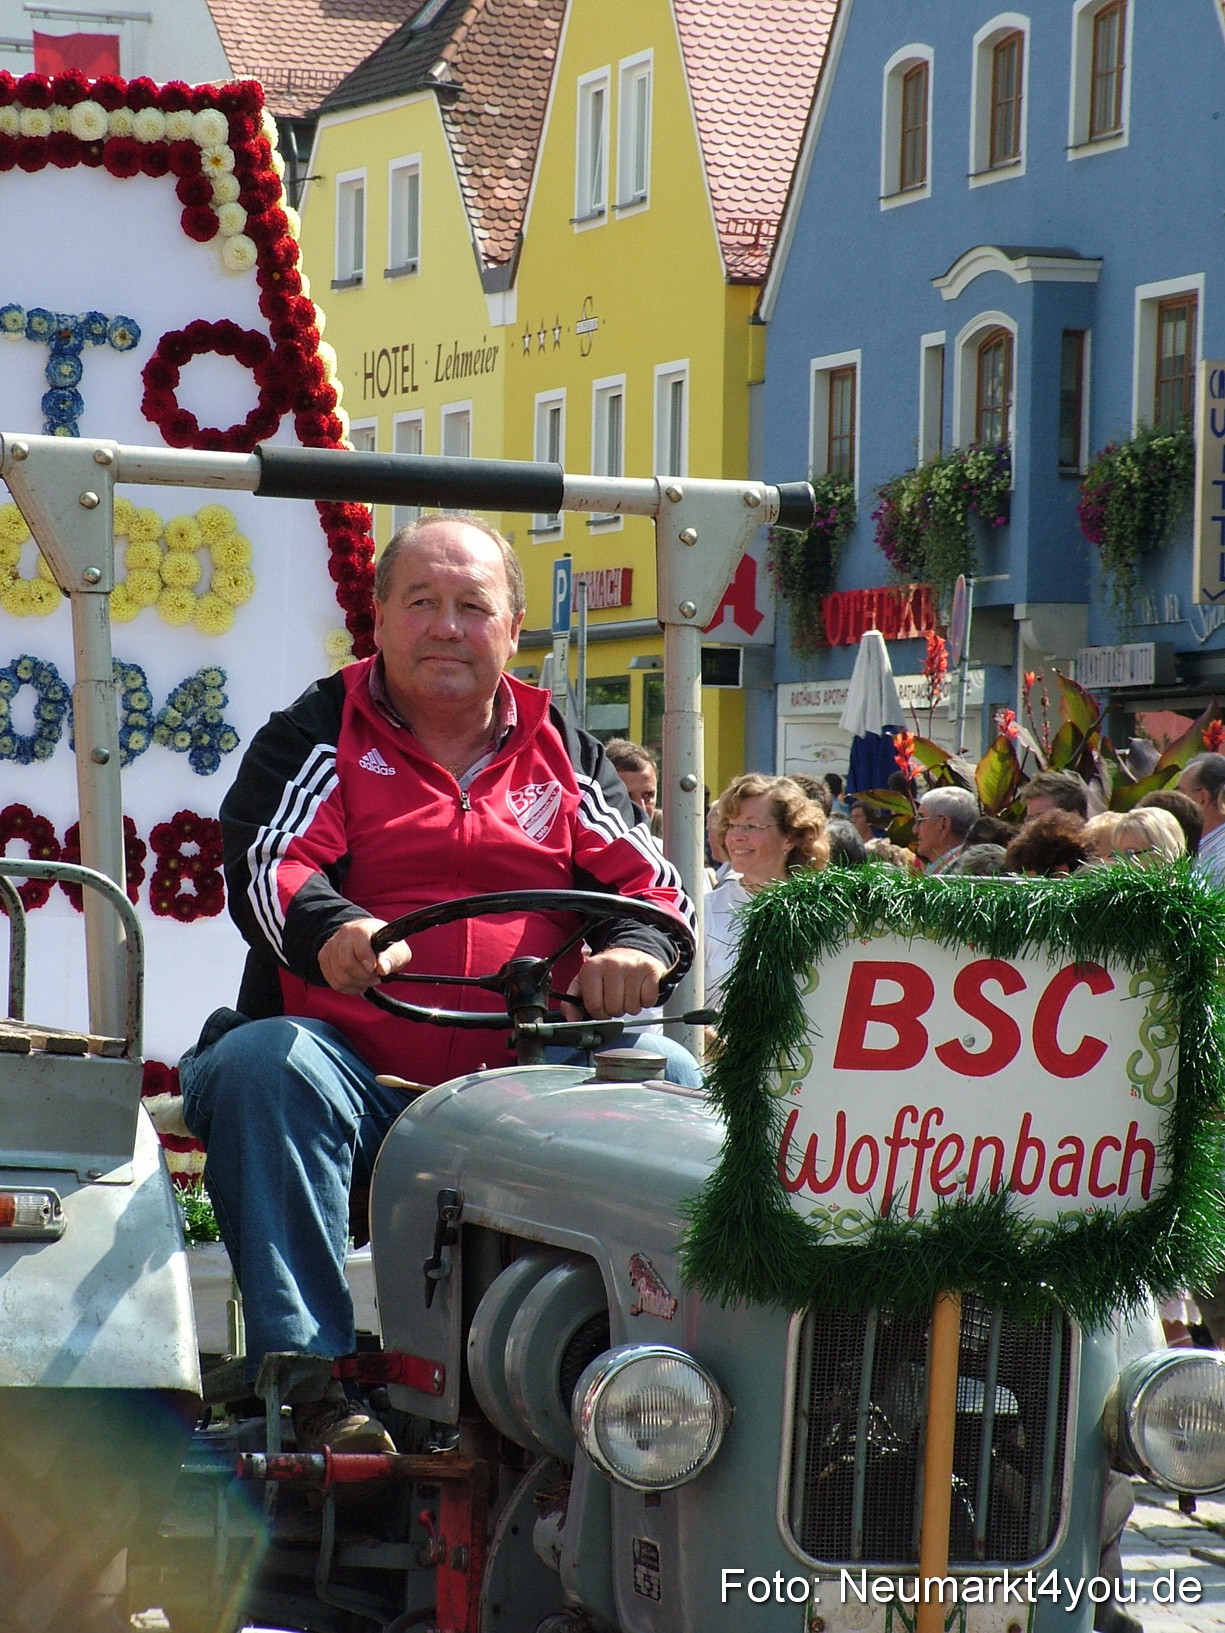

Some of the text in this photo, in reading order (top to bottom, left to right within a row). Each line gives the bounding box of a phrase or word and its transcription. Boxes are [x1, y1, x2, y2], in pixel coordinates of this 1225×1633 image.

[363, 335, 500, 400] HOTEL Lehmeier
[556, 569, 568, 624] P
[791, 690, 821, 707] RATHAUS
[358, 758, 397, 776] adidas
[833, 958, 1115, 1079] BSC
[778, 1105, 1157, 1218] Woffenbach
